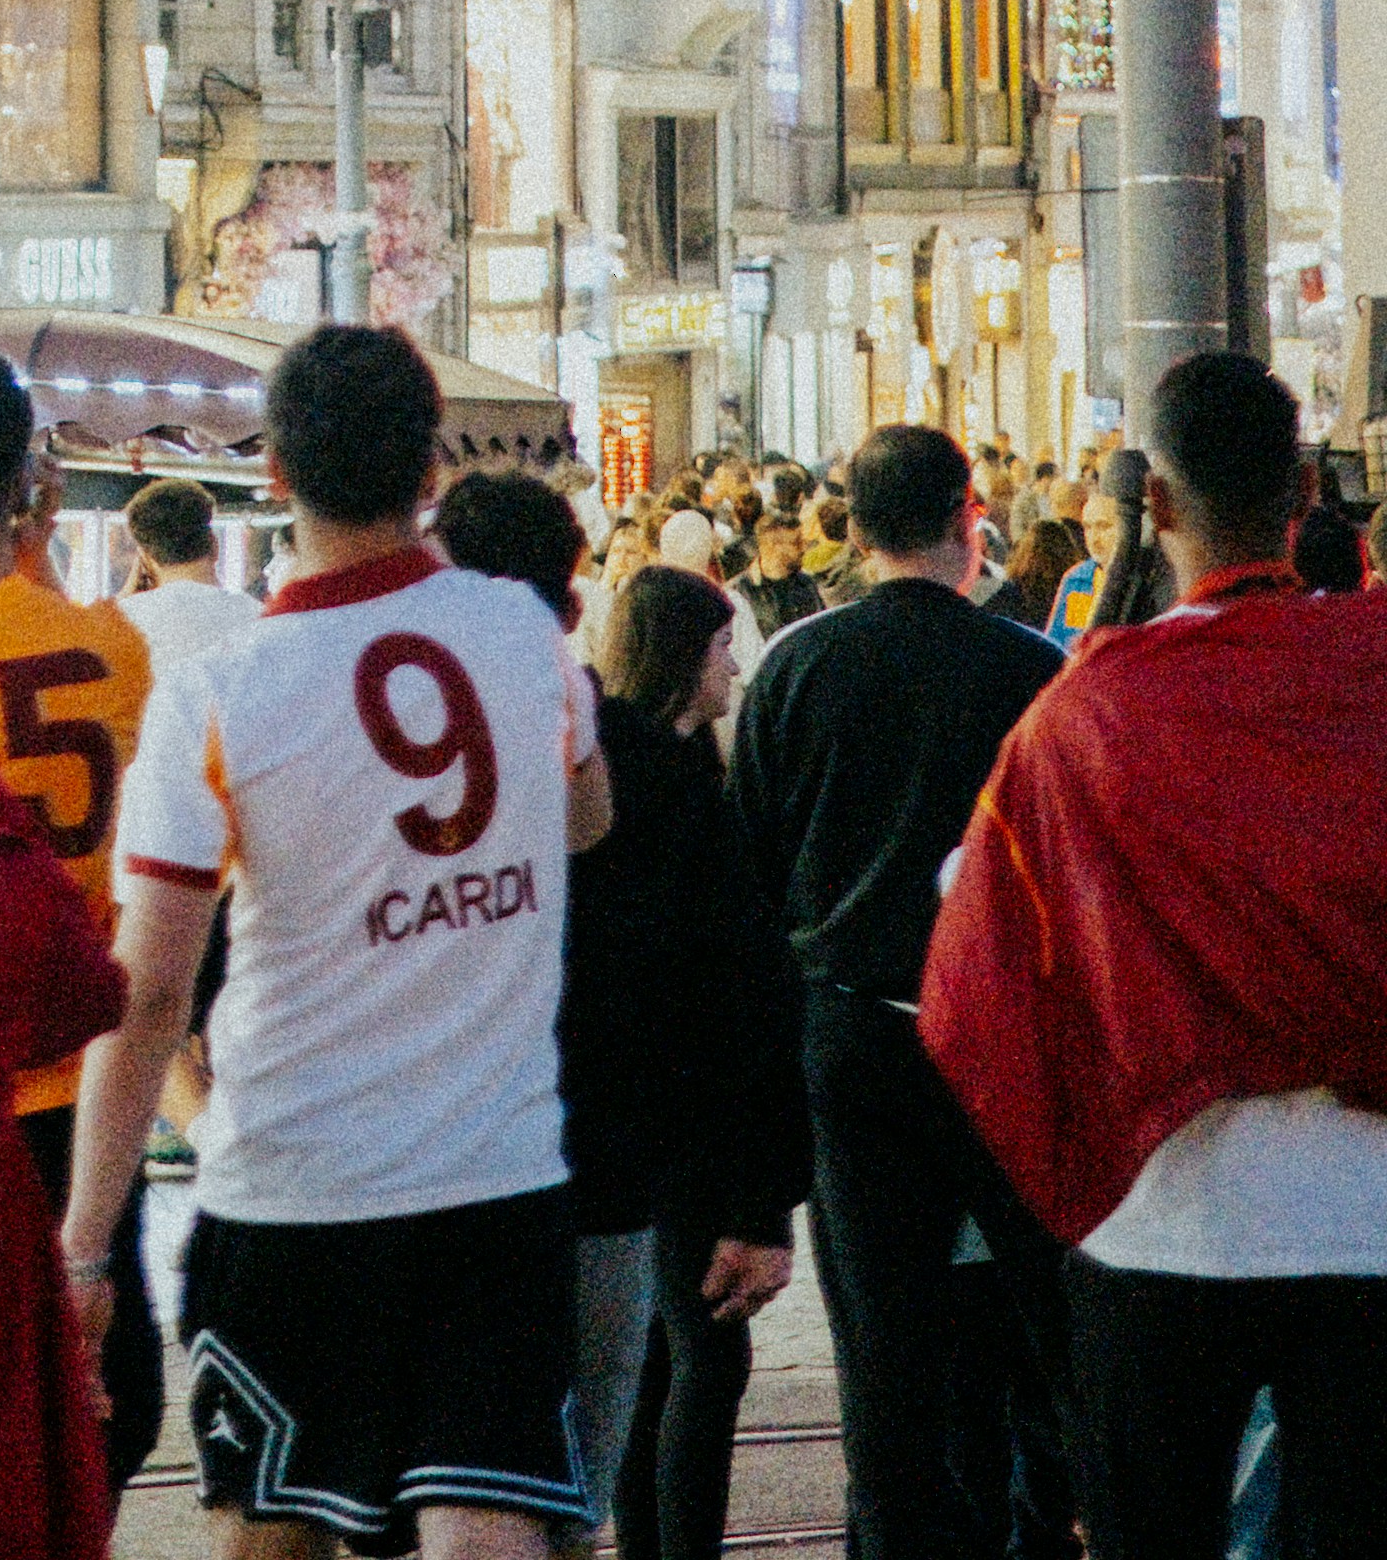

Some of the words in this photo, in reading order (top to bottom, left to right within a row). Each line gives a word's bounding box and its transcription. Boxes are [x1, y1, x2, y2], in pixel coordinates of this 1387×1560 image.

[17, 236, 113, 304] GUESS
[354, 630, 499, 857] 9
[365, 859, 538, 947] ICARDI
